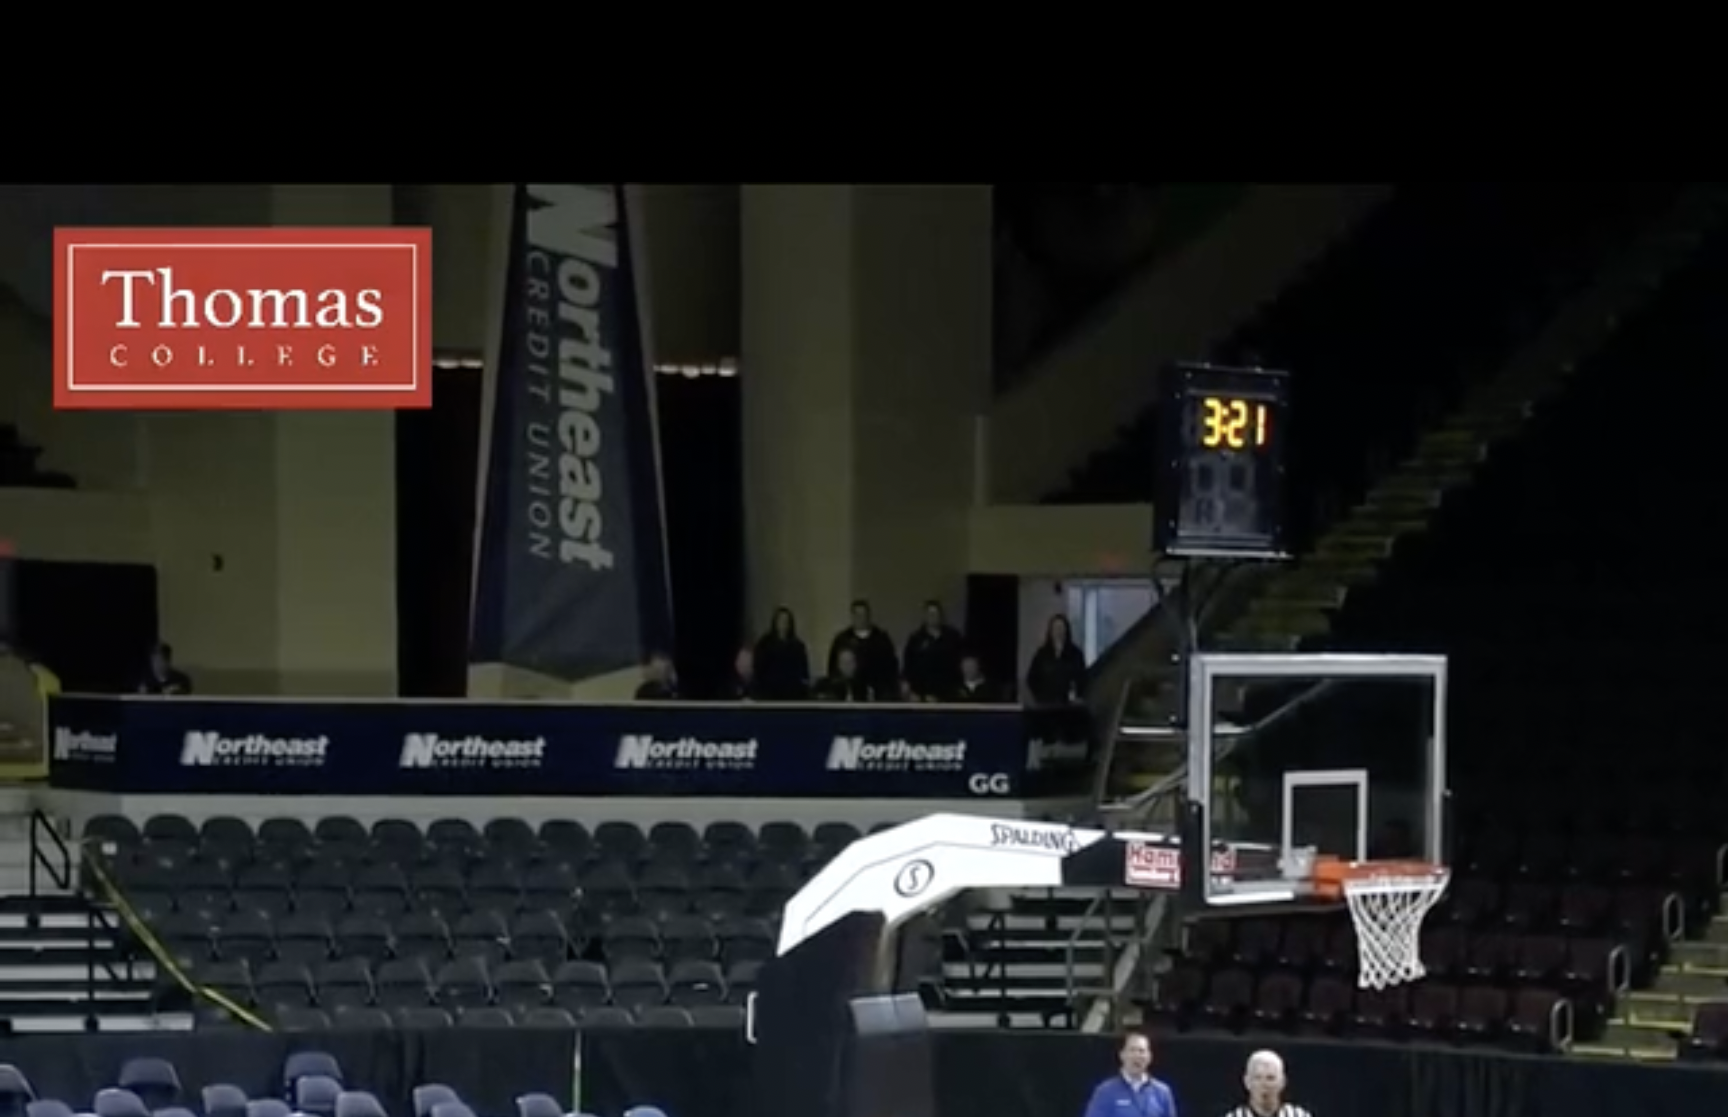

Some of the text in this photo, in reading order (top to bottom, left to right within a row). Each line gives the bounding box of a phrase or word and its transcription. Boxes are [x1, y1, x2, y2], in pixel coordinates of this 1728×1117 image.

[526, 184, 619, 572] Northeast
[526, 251, 552, 558] CREDIT UNION
[1202, 398, 1267, 448] 3:21
[179, 730, 330, 766] Northeast
[399, 732, 547, 768] Northeast
[614, 734, 759, 769] Northeast
[825, 736, 967, 771] Northeast
[968, 772, 1010, 794] GG
[991, 822, 1078, 851] SPALDING
